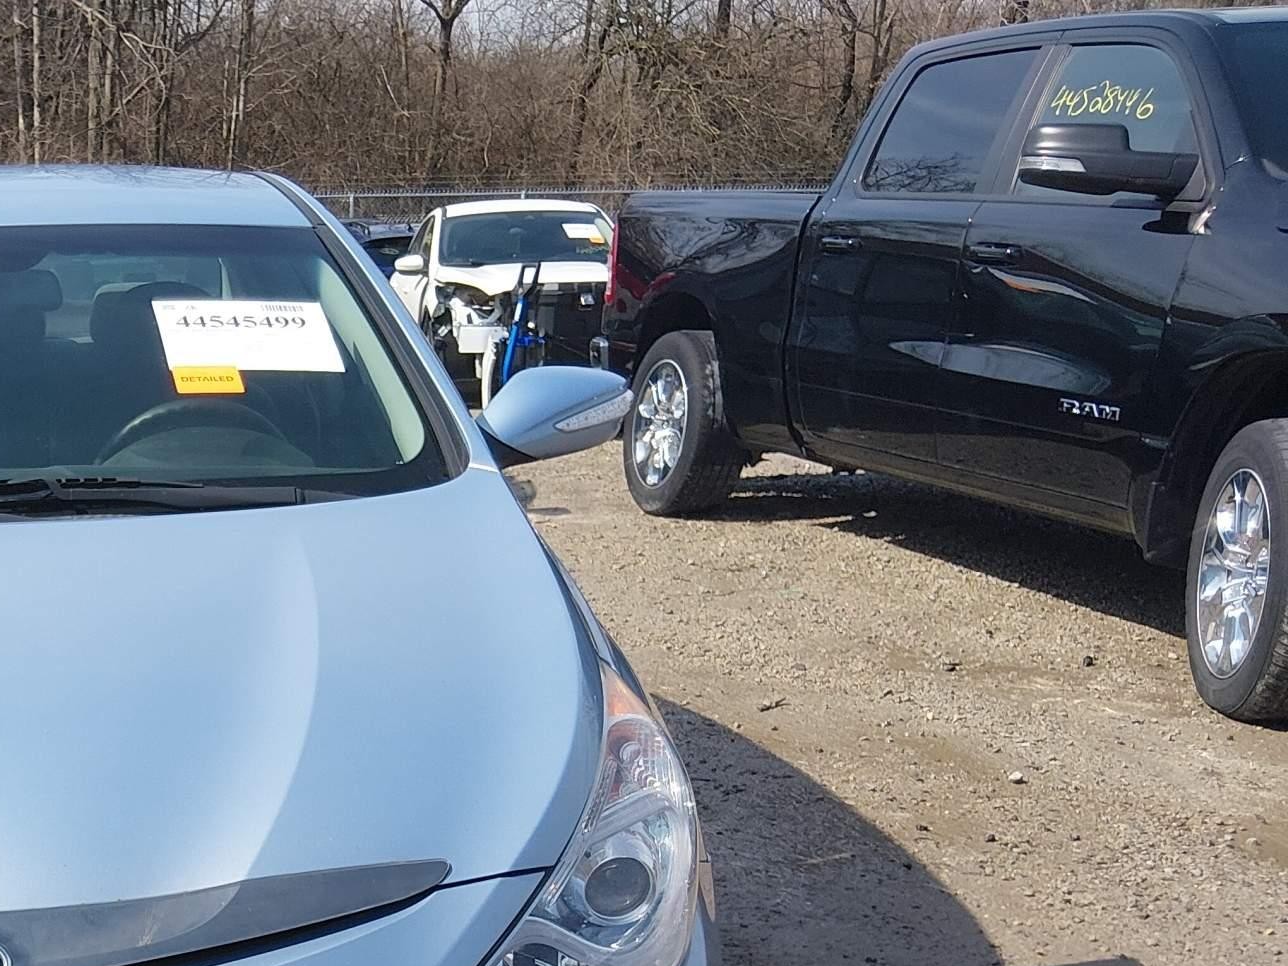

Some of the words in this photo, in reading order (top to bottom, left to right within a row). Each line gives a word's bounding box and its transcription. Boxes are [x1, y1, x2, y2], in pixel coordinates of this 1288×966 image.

[1050, 79, 1155, 120] 44528446
[175, 315, 307, 329] 44545499
[180, 375, 235, 383] DETAILED
[1058, 398, 1121, 421] RAM
